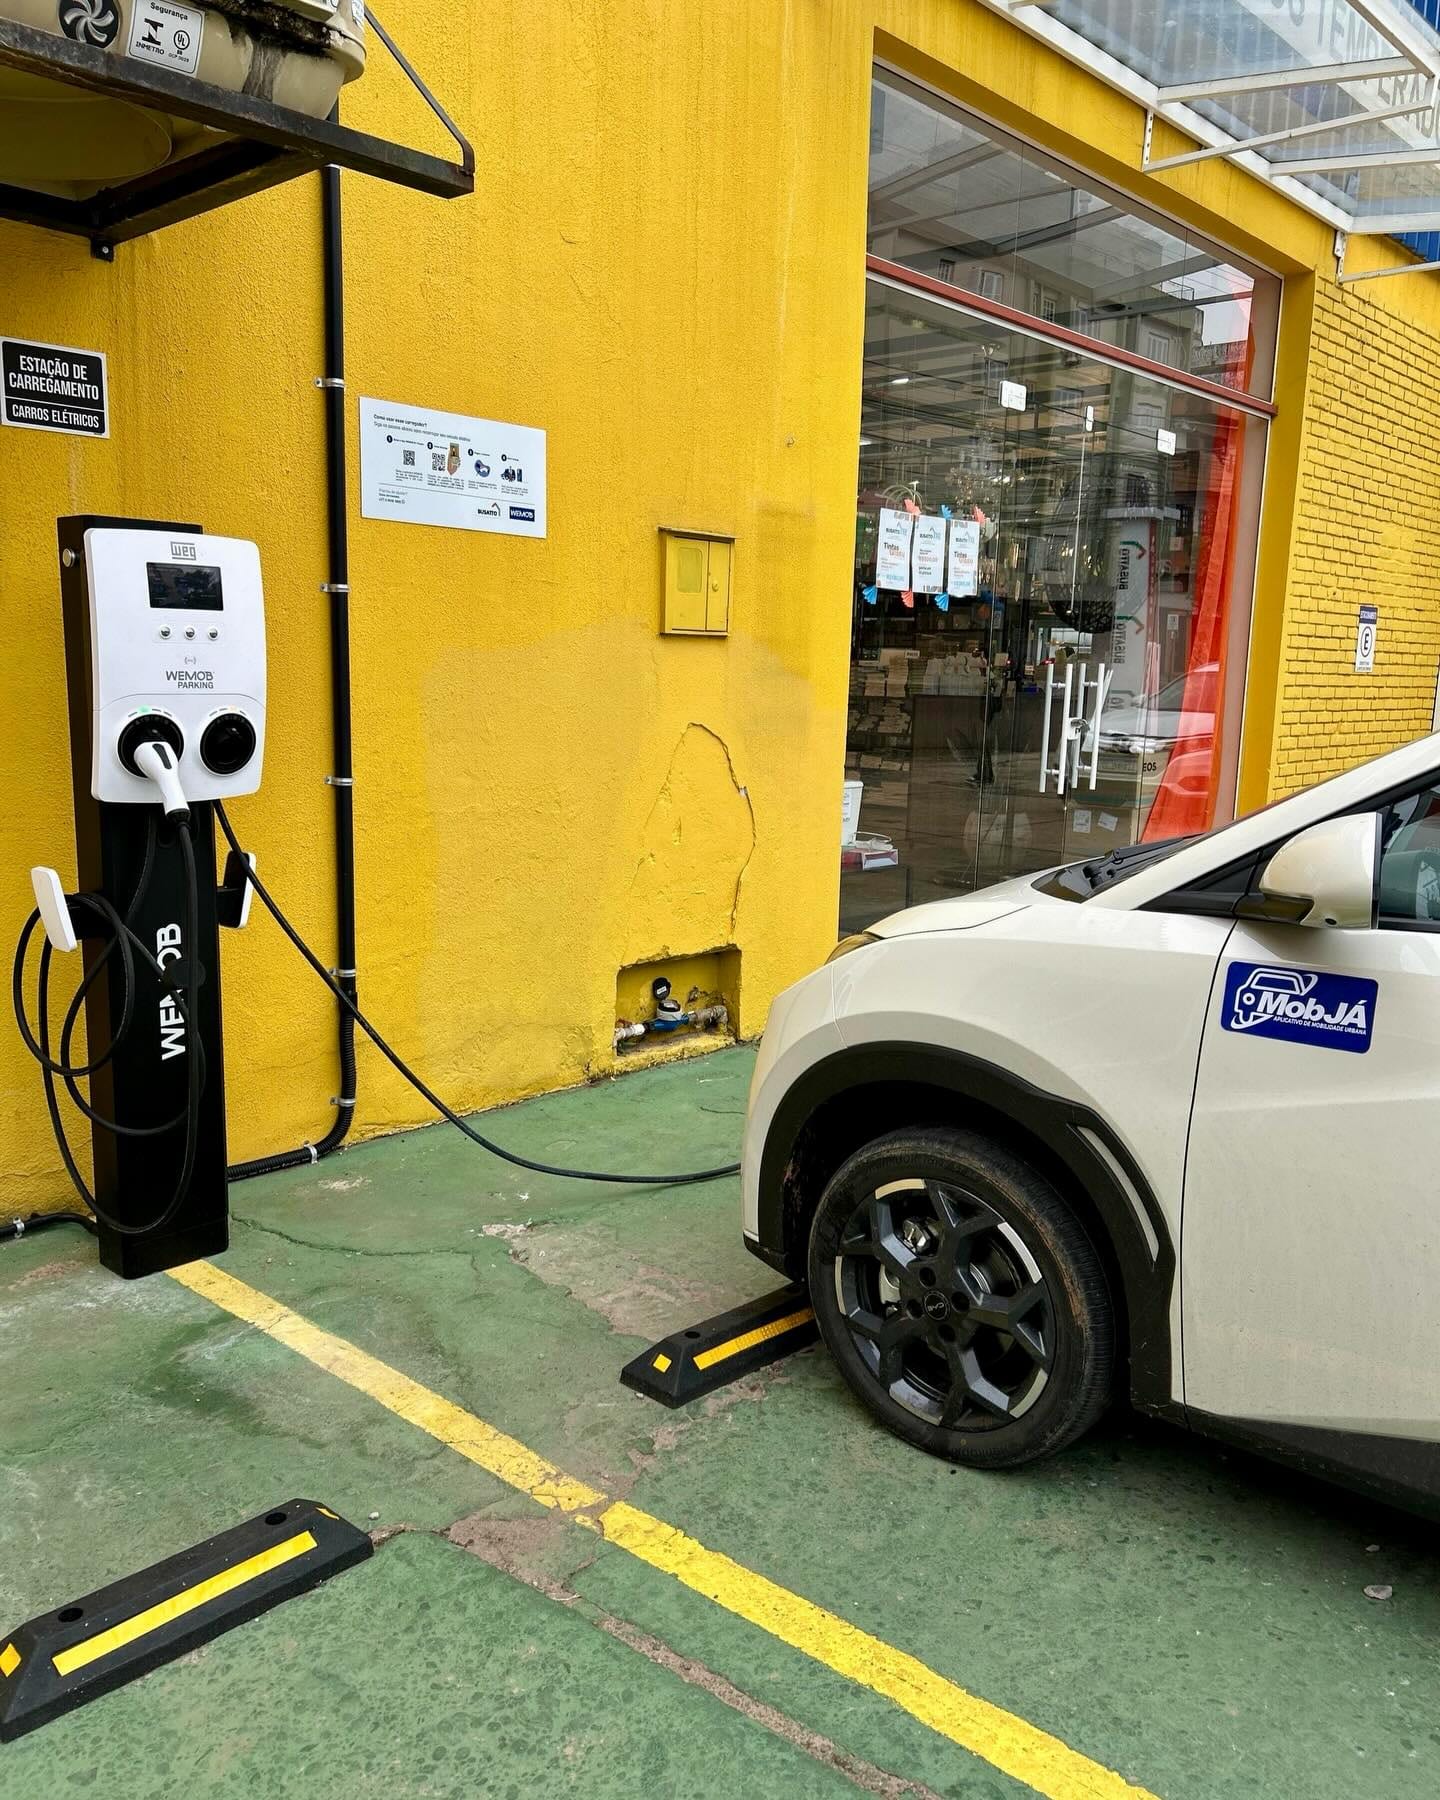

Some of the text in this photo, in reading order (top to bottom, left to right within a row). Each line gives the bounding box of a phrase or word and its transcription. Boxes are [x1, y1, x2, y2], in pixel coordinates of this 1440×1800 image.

[150, 2, 188, 20] Segurança
[136, 41, 165, 55] INMETRO
[20, 354, 88, 380] ESTAÇÃO DE
[9, 372, 99, 400] CARREGAMENTO
[12, 404, 99, 428] CARROS ELÉTRICOS
[510, 509, 534, 519] WEMOB
[165, 670, 214, 681] WEMOB
[177, 681, 214, 689] PARKING
[1273, 1016, 1303, 1026] APLICATIVO
[1311, 1022, 1344, 1032] MOBILIDADE
[1344, 1027, 1367, 1036] URBANA
